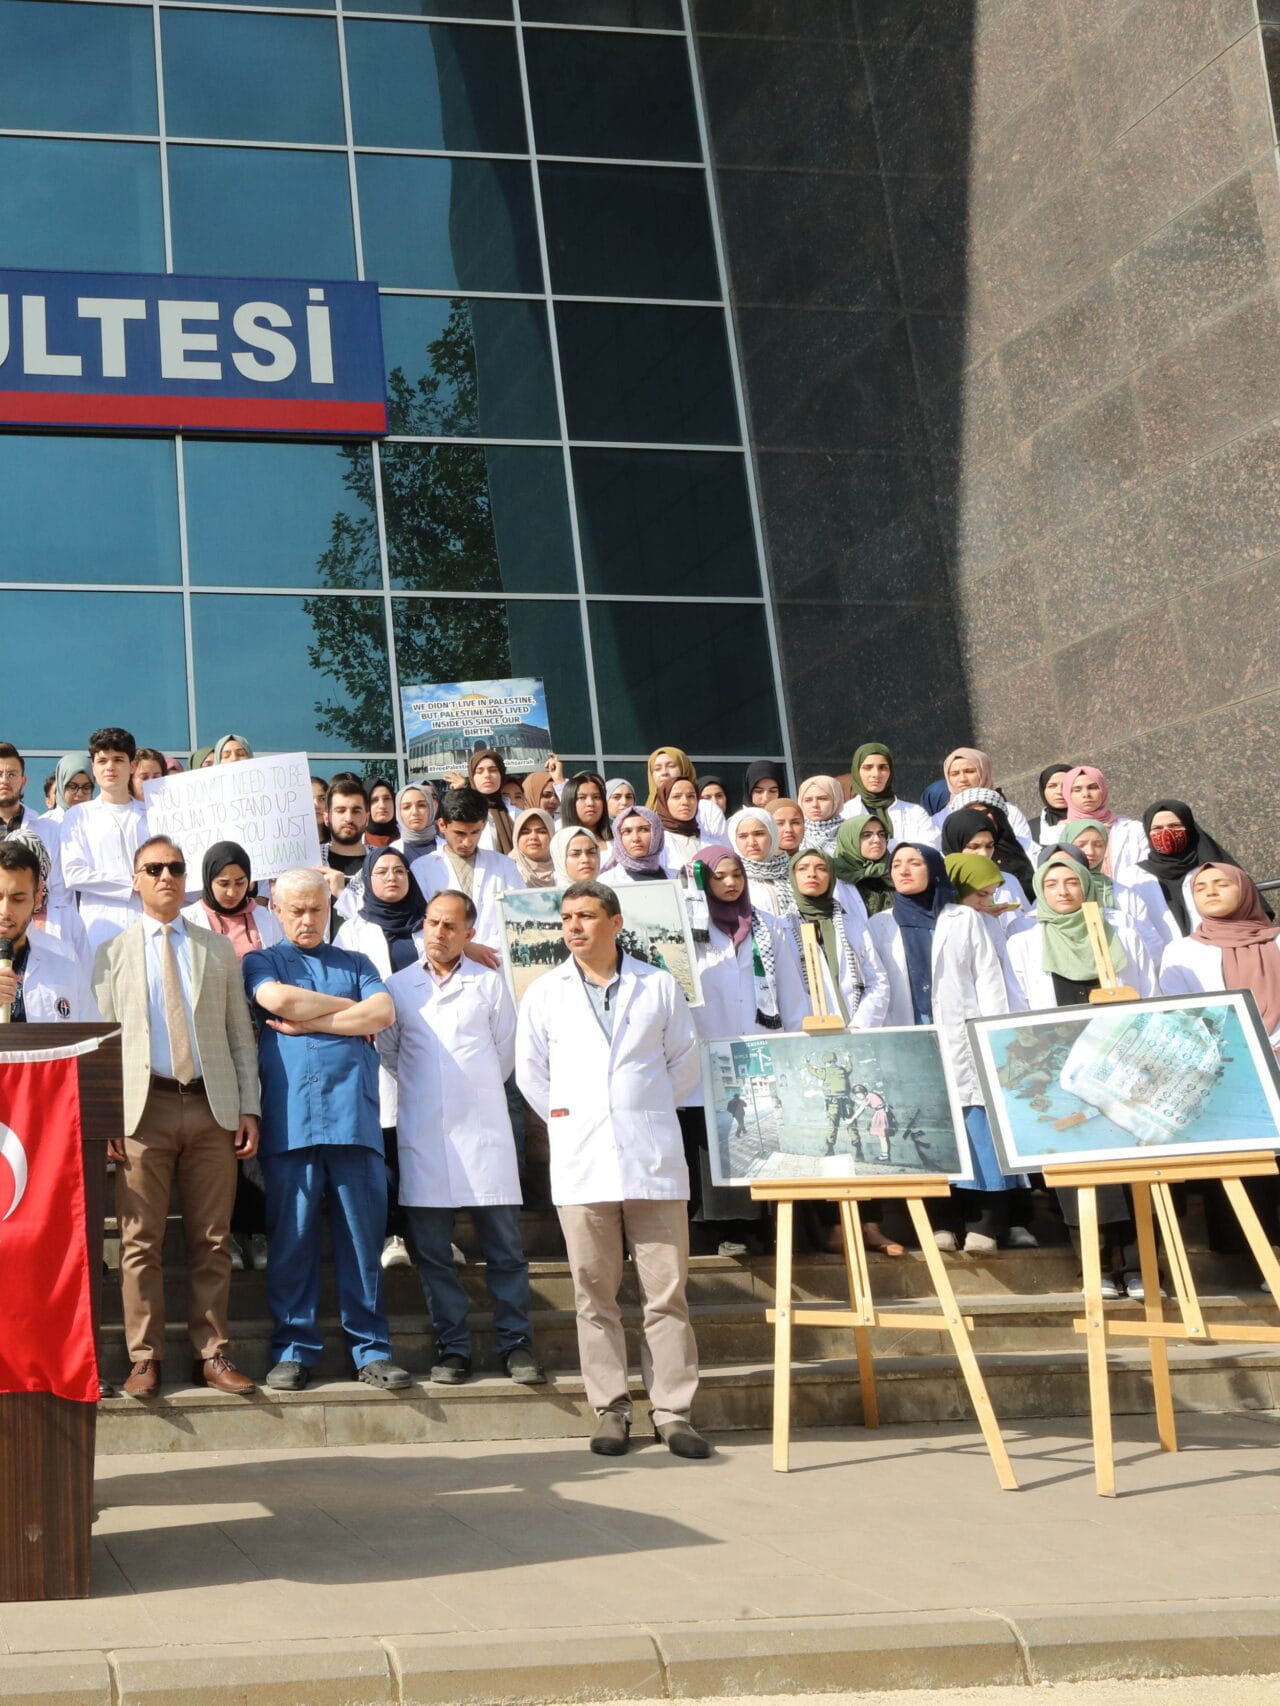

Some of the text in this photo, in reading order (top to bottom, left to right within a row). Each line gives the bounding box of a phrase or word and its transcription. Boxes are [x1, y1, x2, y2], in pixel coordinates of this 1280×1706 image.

[413, 703, 426, 711] WE
[428, 701, 456, 710] DIDN'T
[458, 699, 476, 708] LIVE
[478, 698, 487, 706] IN
[421, 712, 438, 720] BUT
[440, 709, 484, 719] PALESTINE
[505, 706, 529, 714] LIVED
[432, 720, 459, 728] INSIDE
[476, 717, 500, 725] SINCE
[501, 716, 521, 724] OUR
[464, 727, 492, 736] BIRTH.
[233, 768, 266, 795] NEED
[271, 765, 287, 790] TO
[289, 762, 305, 788] BE
[209, 801, 227, 826] TO
[230, 794, 273, 822] STAND
[275, 790, 298, 815] UP
[236, 820, 266, 844] YOU
[273, 812, 310, 839] JUST
[251, 840, 309, 866] HUMAN
